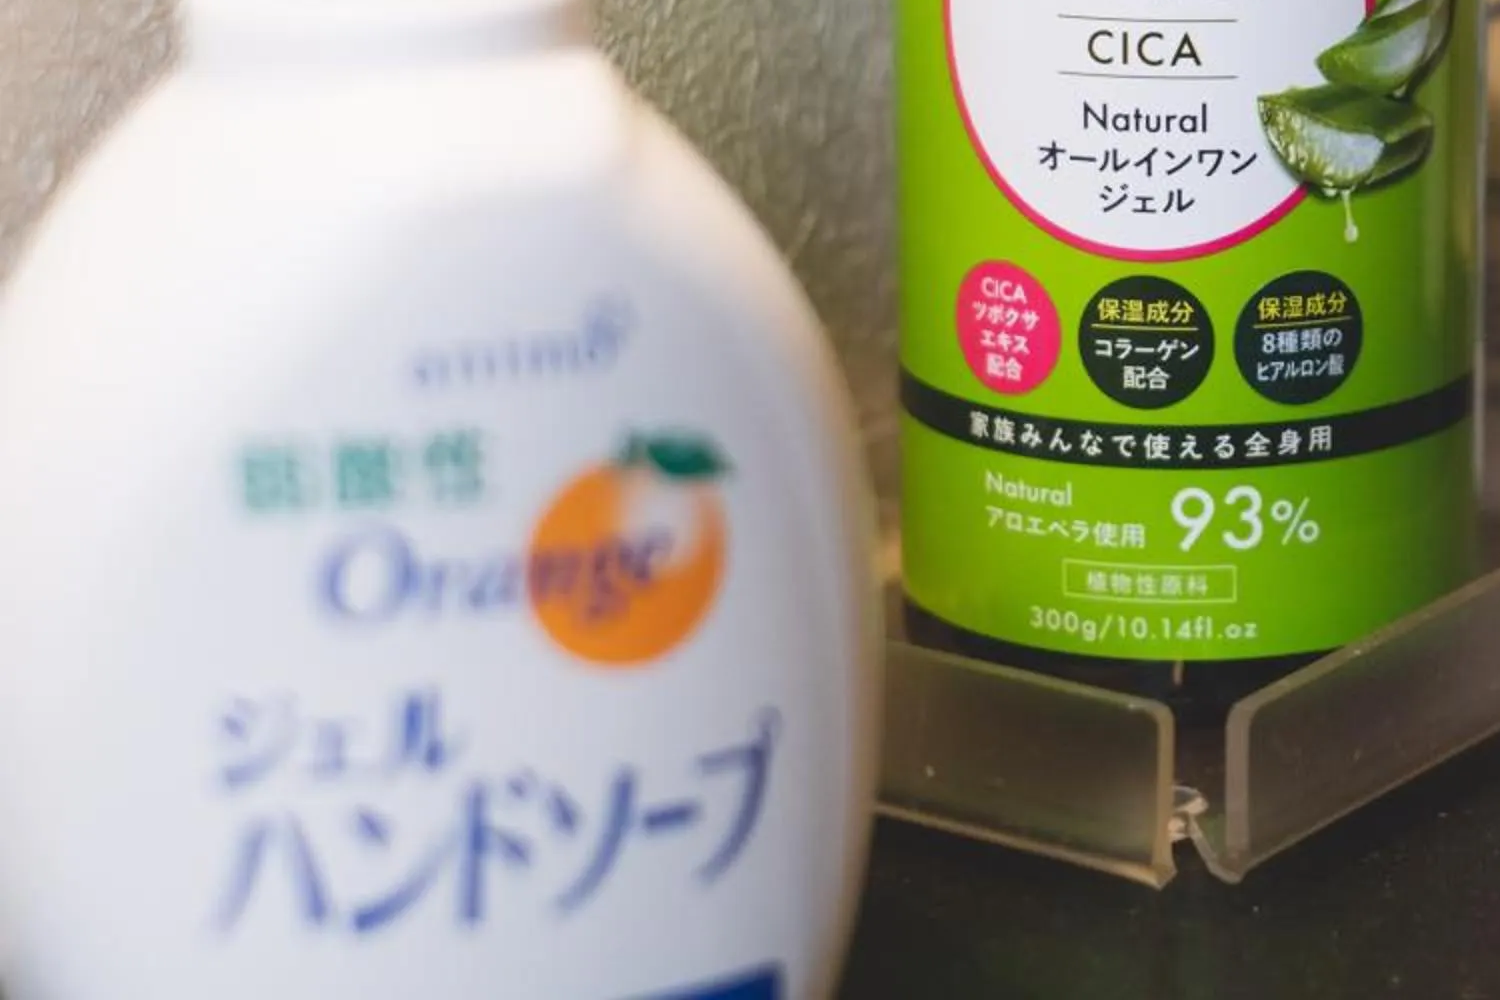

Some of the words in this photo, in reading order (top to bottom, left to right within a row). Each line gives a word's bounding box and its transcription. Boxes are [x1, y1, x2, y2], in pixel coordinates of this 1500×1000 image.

[1086, 29, 1203, 67] CICA
[1082, 101, 1208, 134] Natural
[1038, 140, 1258, 178] オールインワン
[1100, 184, 1196, 214] ジェル
[981, 276, 1028, 304] CICA
[1256, 290, 1348, 321] 保湿成分
[1097, 297, 1196, 324] 保湿成分
[980, 328, 1031, 355] エキス
[1094, 337, 1200, 362] コラーゲン
[1261, 327, 1343, 355] 8種類の
[985, 351, 1024, 382] 配合
[1122, 364, 1171, 391] 配合
[968, 409, 1334, 461] 家族みんなで使える全身用
[984, 470, 1074, 508] Natural
[1170, 484, 1322, 552] 93%
[314, 522, 674, 628] Orange
[214, 684, 466, 792] ジェル
[208, 704, 784, 938] ハンドソープ
